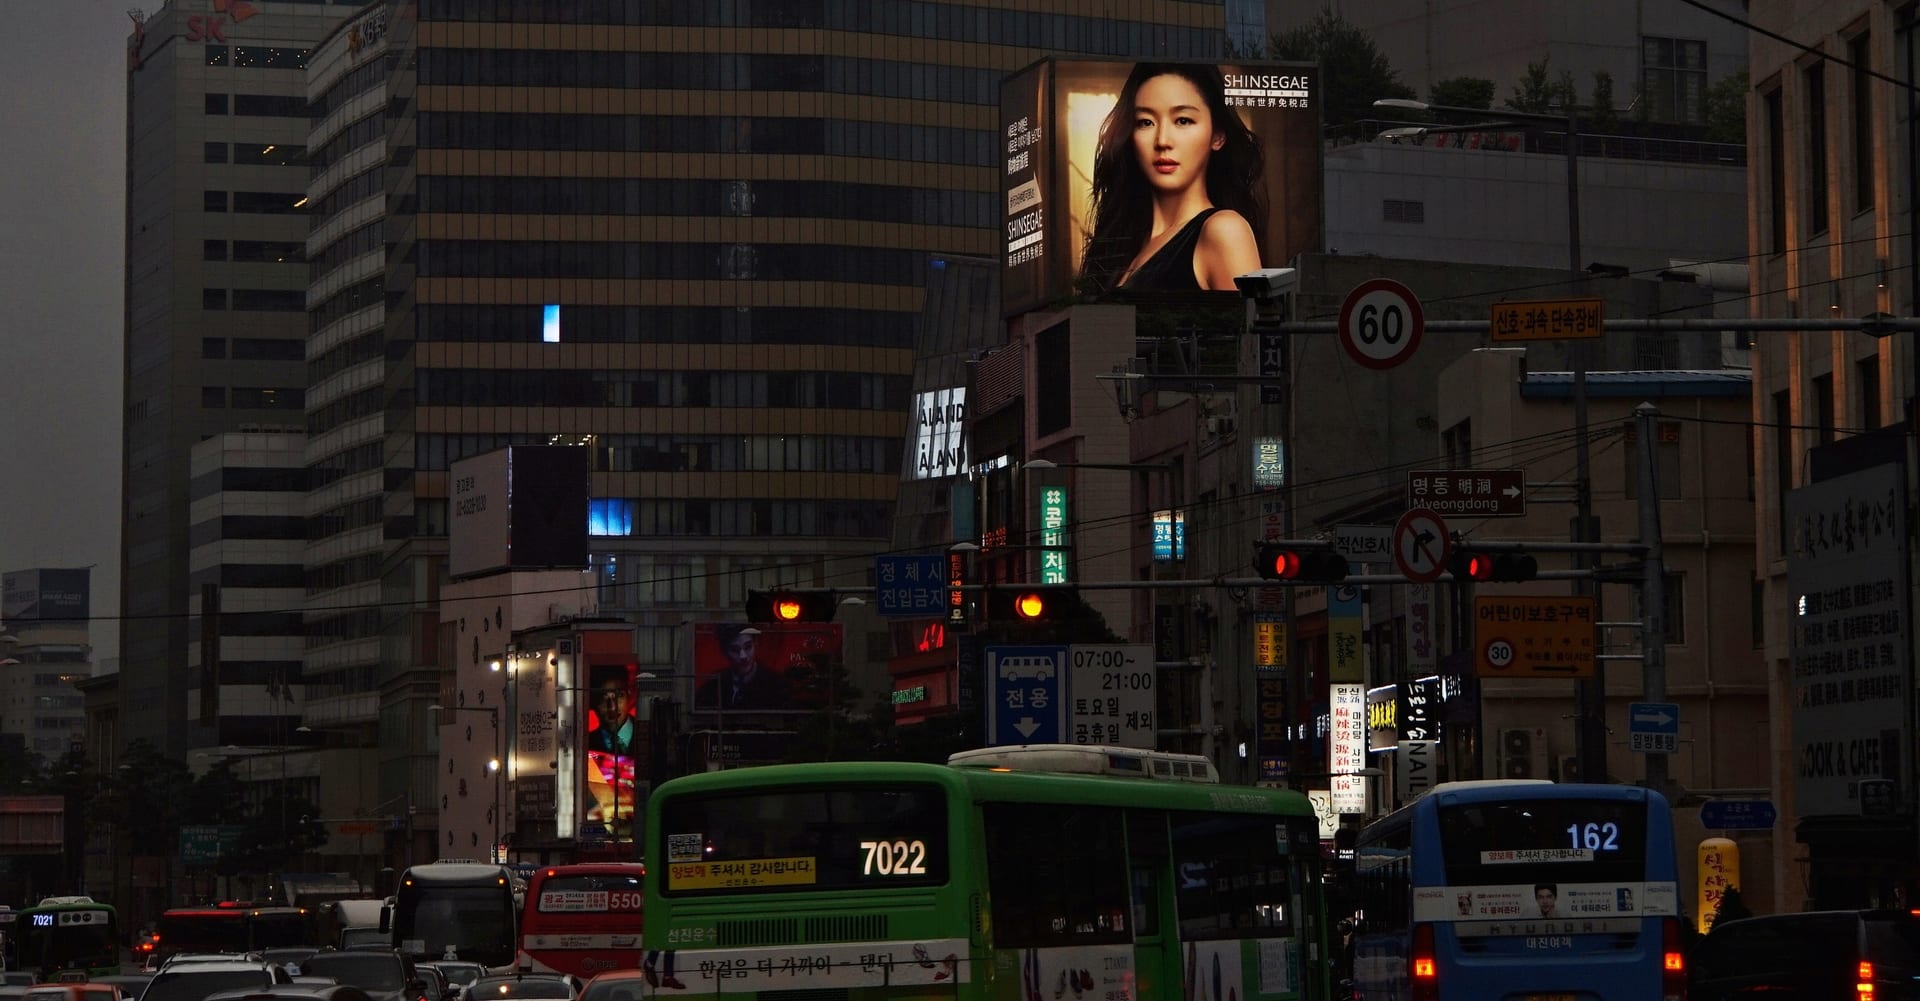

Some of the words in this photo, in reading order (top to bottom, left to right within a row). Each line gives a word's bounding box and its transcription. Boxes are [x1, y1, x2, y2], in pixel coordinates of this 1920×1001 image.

[185, 16, 226, 42] SK
[1224, 75, 1309, 89] SHINSEGAE
[1008, 209, 1043, 240] SHINSEGAE
[1359, 304, 1403, 344] 60
[1552, 305, 1599, 332] 단속장비
[1256, 463, 1283, 474] 수선
[1413, 477, 1450, 495] 명동
[1458, 478, 1491, 495] 明洞
[1413, 498, 1498, 512] Myeongdong
[1045, 507, 1065, 584] 콤비치과
[1337, 536, 1390, 554] 적신호시
[882, 587, 944, 608] 진입금지
[1480, 605, 1590, 622] 어린이보호구역
[1074, 651, 1135, 668] 07:00~
[1491, 647, 1509, 660] 30
[1102, 672, 1152, 690] 21:00
[1006, 688, 1049, 709] 전용
[1075, 697, 1119, 717] 토요일
[1126, 711, 1153, 731] 제외
[1075, 723, 1119, 743] 공휴일
[1633, 734, 1674, 750] 일방통행
[1837, 741, 1846, 776] &
[1850, 737, 1879, 777] CAFE
[1409, 743, 1428, 793] NAIL
[1567, 822, 1619, 850] 162
[860, 840, 926, 875] 7022
[1516, 850, 1540, 859] 주셔서
[672, 865, 706, 879] 양보해
[711, 863, 745, 877] 주셔서
[751, 860, 813, 875] 감사합니다.
[544, 895, 564, 904] 광교
[611, 893, 643, 908] 550
[33, 915, 53, 926] 7021
[667, 928, 717, 943] 선진운수
[1526, 935, 1572, 950] 대진여객
[700, 958, 748, 979] 한걸음
[757, 957, 772, 977] 더
[780, 955, 830, 976] 가까이
[860, 953, 893, 973] 탠디
